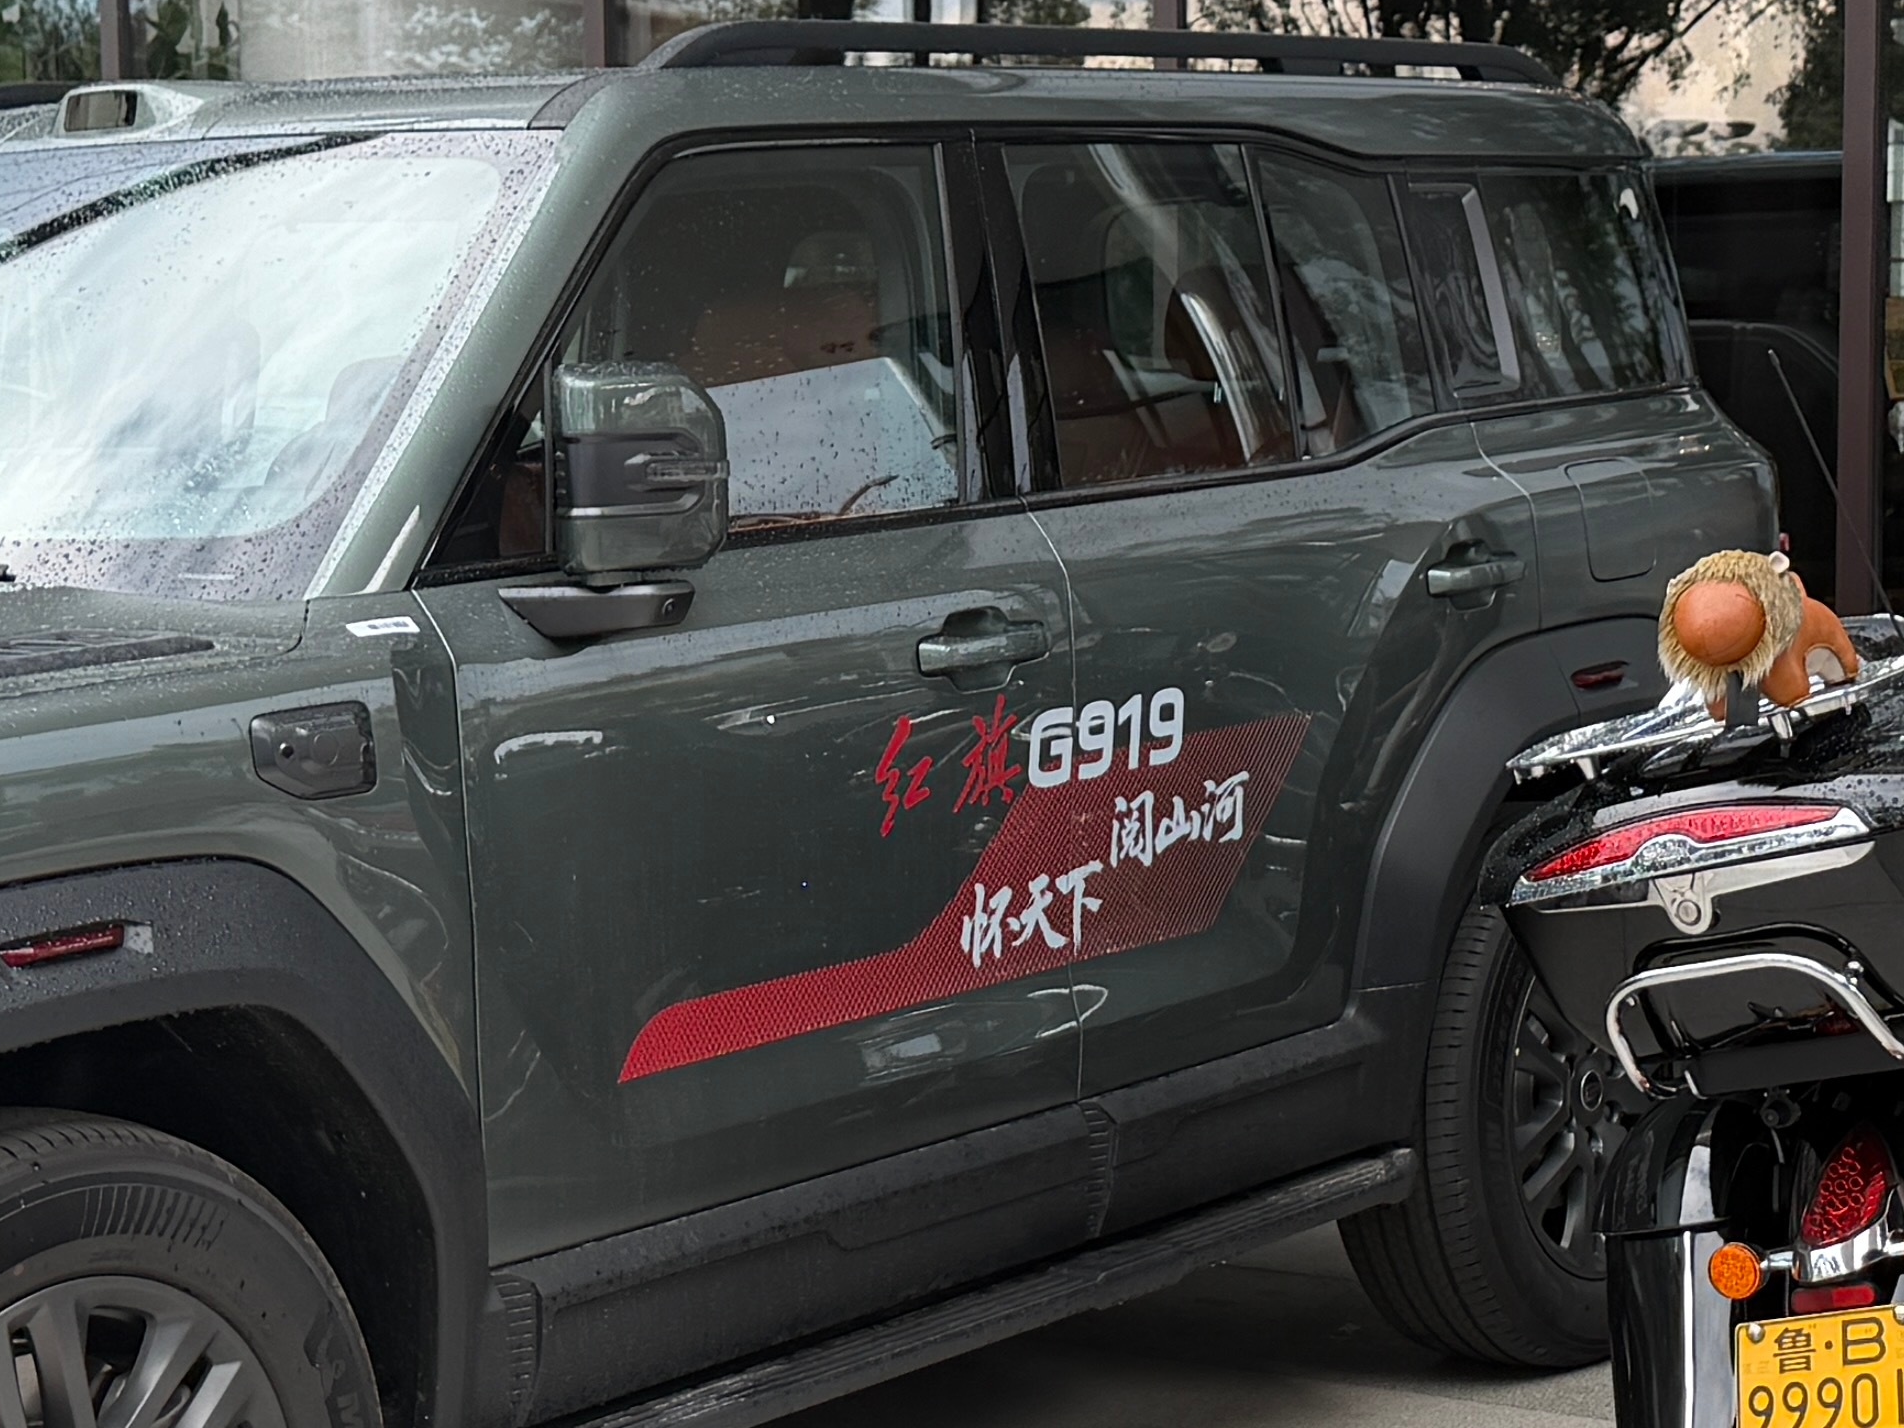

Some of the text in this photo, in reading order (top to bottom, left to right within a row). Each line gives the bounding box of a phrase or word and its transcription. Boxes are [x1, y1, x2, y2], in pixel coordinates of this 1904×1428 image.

[1028, 687, 1184, 788] G919
[1110, 771, 1249, 868] 阅山河
[960, 859, 1104, 969] 怀天下
